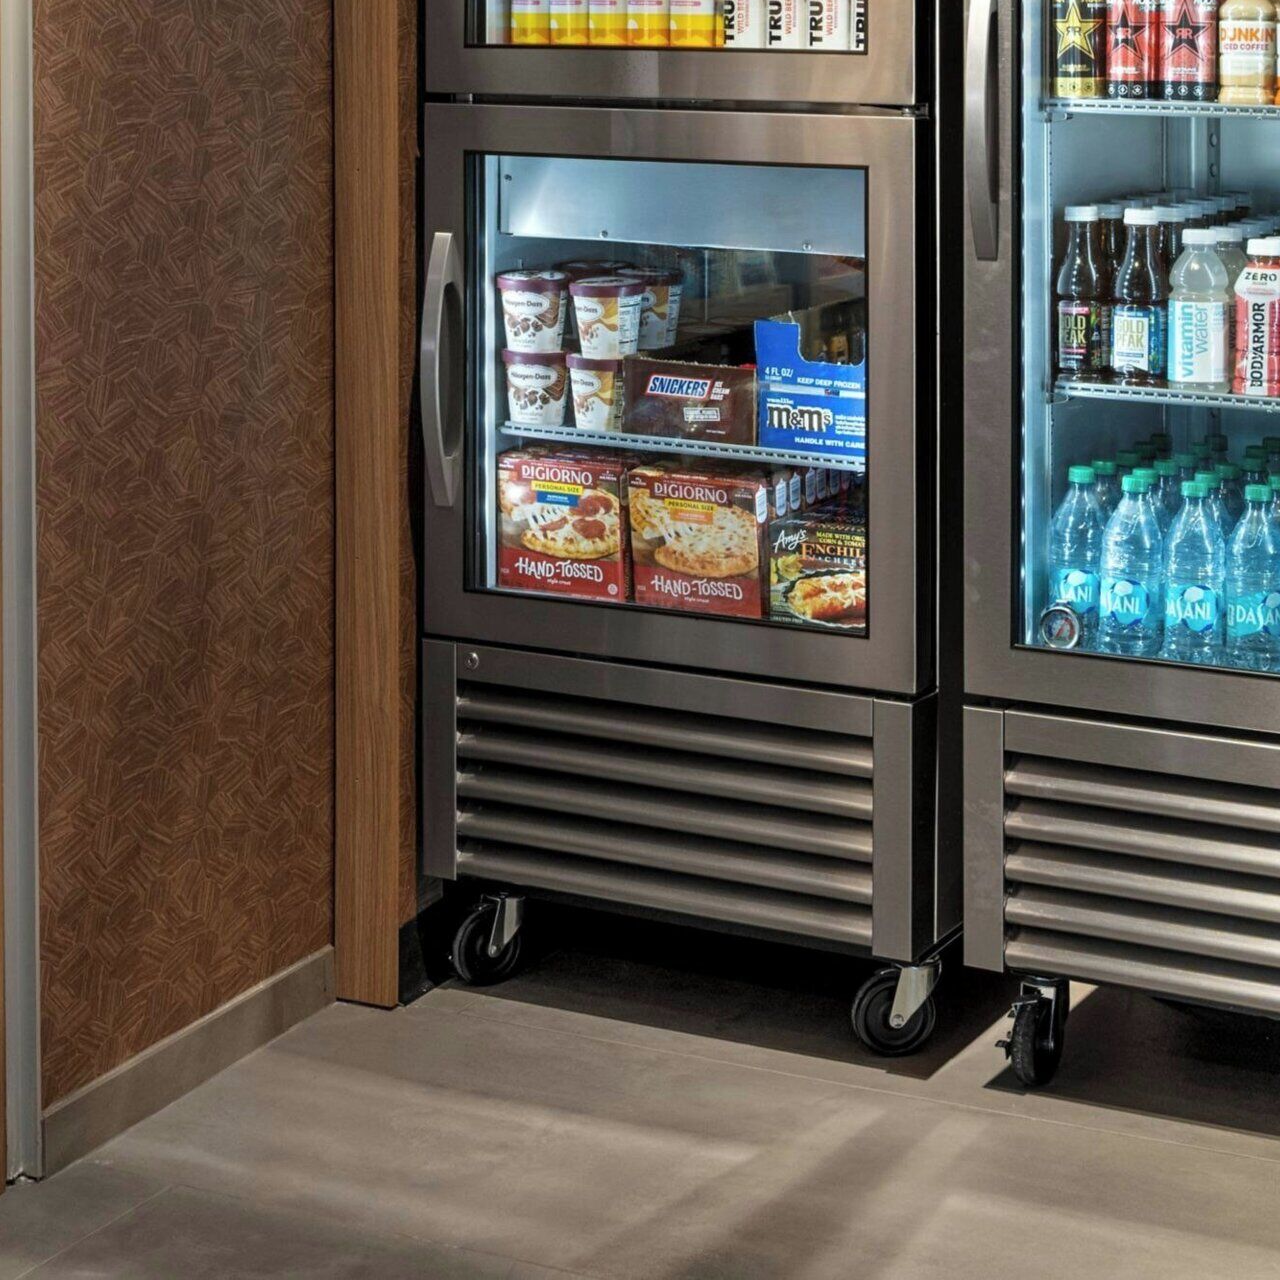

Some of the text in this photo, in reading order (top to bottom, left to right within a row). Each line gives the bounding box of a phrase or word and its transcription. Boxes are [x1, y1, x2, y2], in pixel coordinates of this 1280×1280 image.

[1239, 42, 1271, 52] COFFEE
[1244, 272, 1277, 282] ZERO
[1195, 304, 1208, 354] water
[1180, 303, 1194, 378] vitamin
[1249, 302, 1266, 388] BODYARMOR
[765, 367, 770, 375] 4
[771, 367, 780, 376] FL
[649, 376, 709, 398] SNICKERS
[797, 376, 861, 389] KEEP DEEP FROZEN
[795, 436, 823, 446] HANDLE
[825, 439, 844, 447] WITH
[534, 483, 566, 492] PERSONAL
[668, 501, 700, 510] PERSONAL
[773, 528, 809, 553] Amy's
[801, 542, 865, 561] ENCHIL
